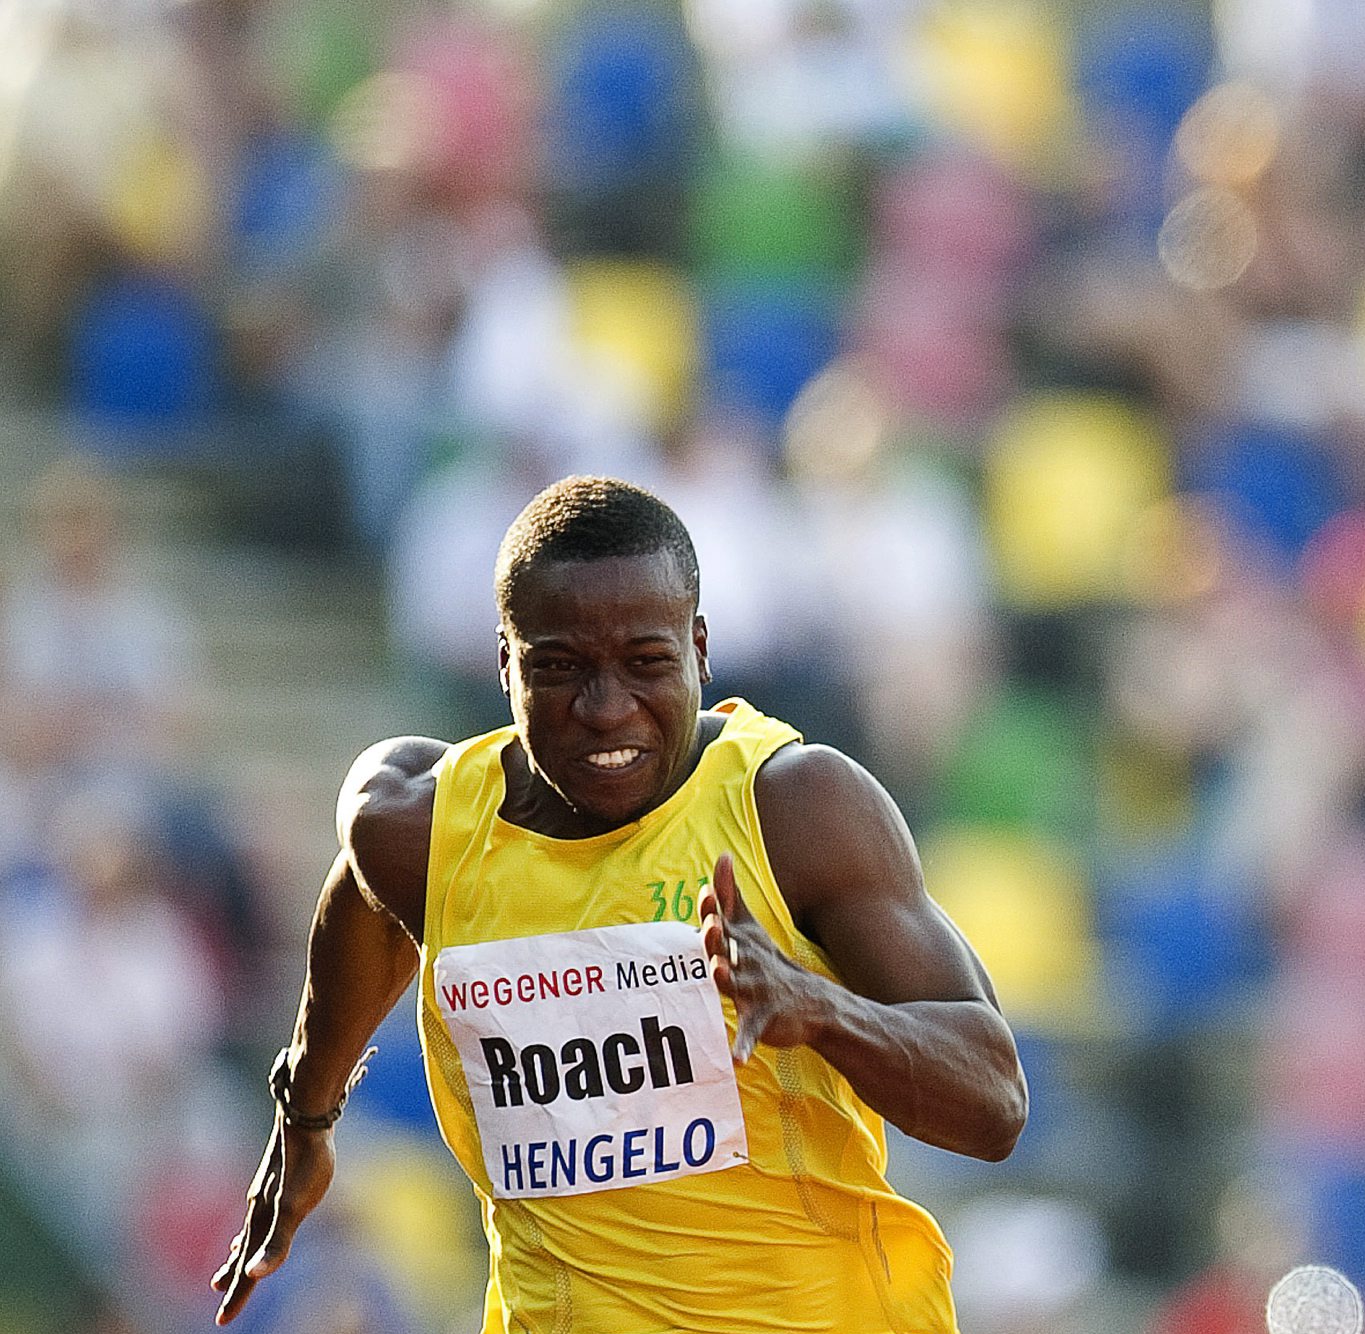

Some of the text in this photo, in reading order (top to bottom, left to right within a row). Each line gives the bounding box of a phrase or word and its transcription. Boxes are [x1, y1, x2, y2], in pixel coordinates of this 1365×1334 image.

[616, 954, 708, 991] Media
[480, 1015, 694, 1108] Roach
[502, 1117, 716, 1191] HENGELO
